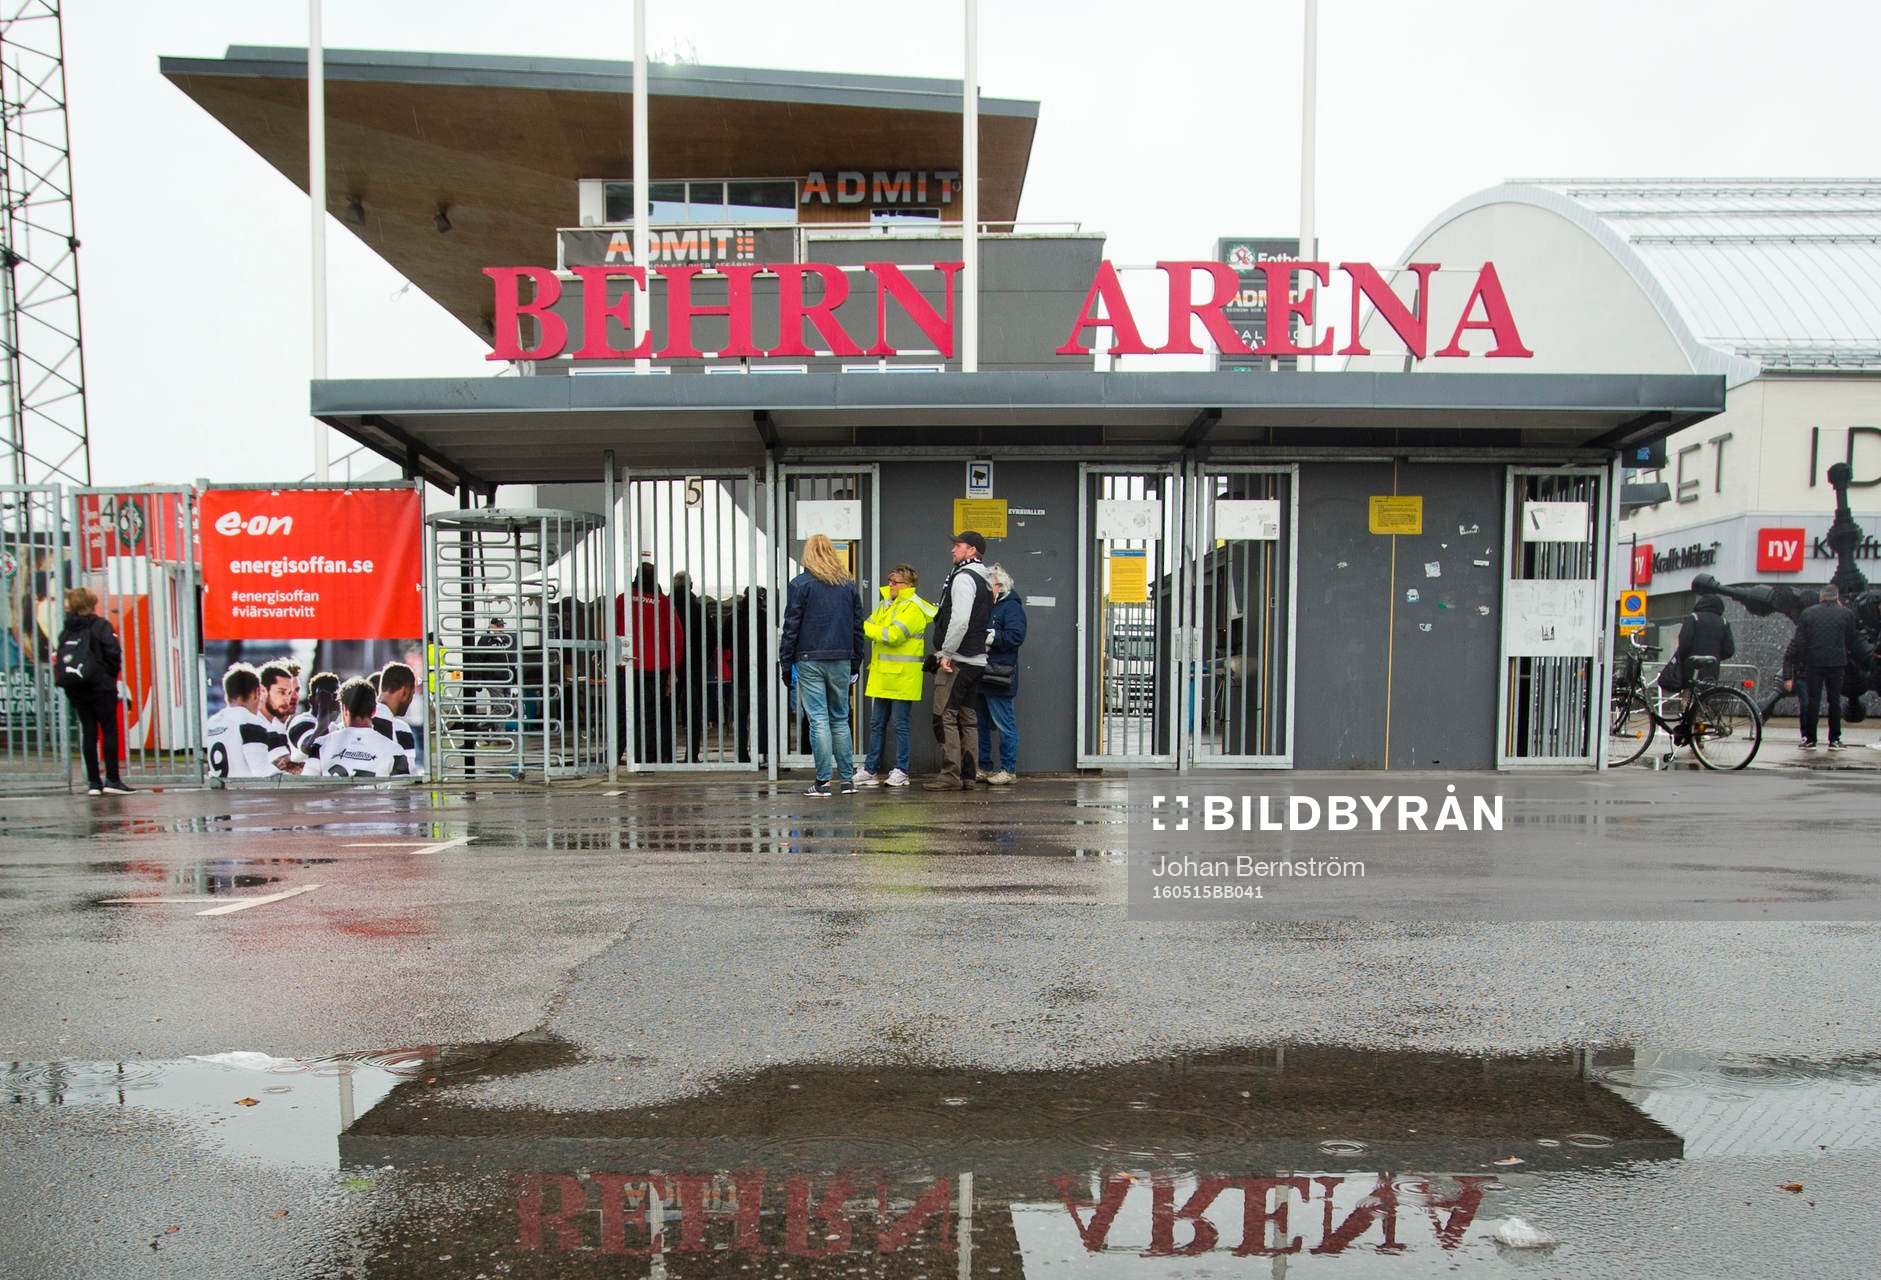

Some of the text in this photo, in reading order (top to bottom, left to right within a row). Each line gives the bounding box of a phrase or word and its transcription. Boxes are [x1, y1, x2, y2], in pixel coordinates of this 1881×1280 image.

[801, 171, 960, 205] ADMIT
[604, 229, 734, 263] ADMIT
[483, 259, 1535, 361] BEHRN ARENA
[686, 478, 703, 506] 5
[100, 496, 115, 523] 4
[1653, 547, 1680, 574] Krafft
[1681, 542, 1716, 569] Måleri
[1768, 539, 1799, 562] ny
[229, 556, 374, 578] energisoffan.se
[231, 589, 320, 605] #energisoffan
[231, 605, 316, 618] #viärsvartvitt
